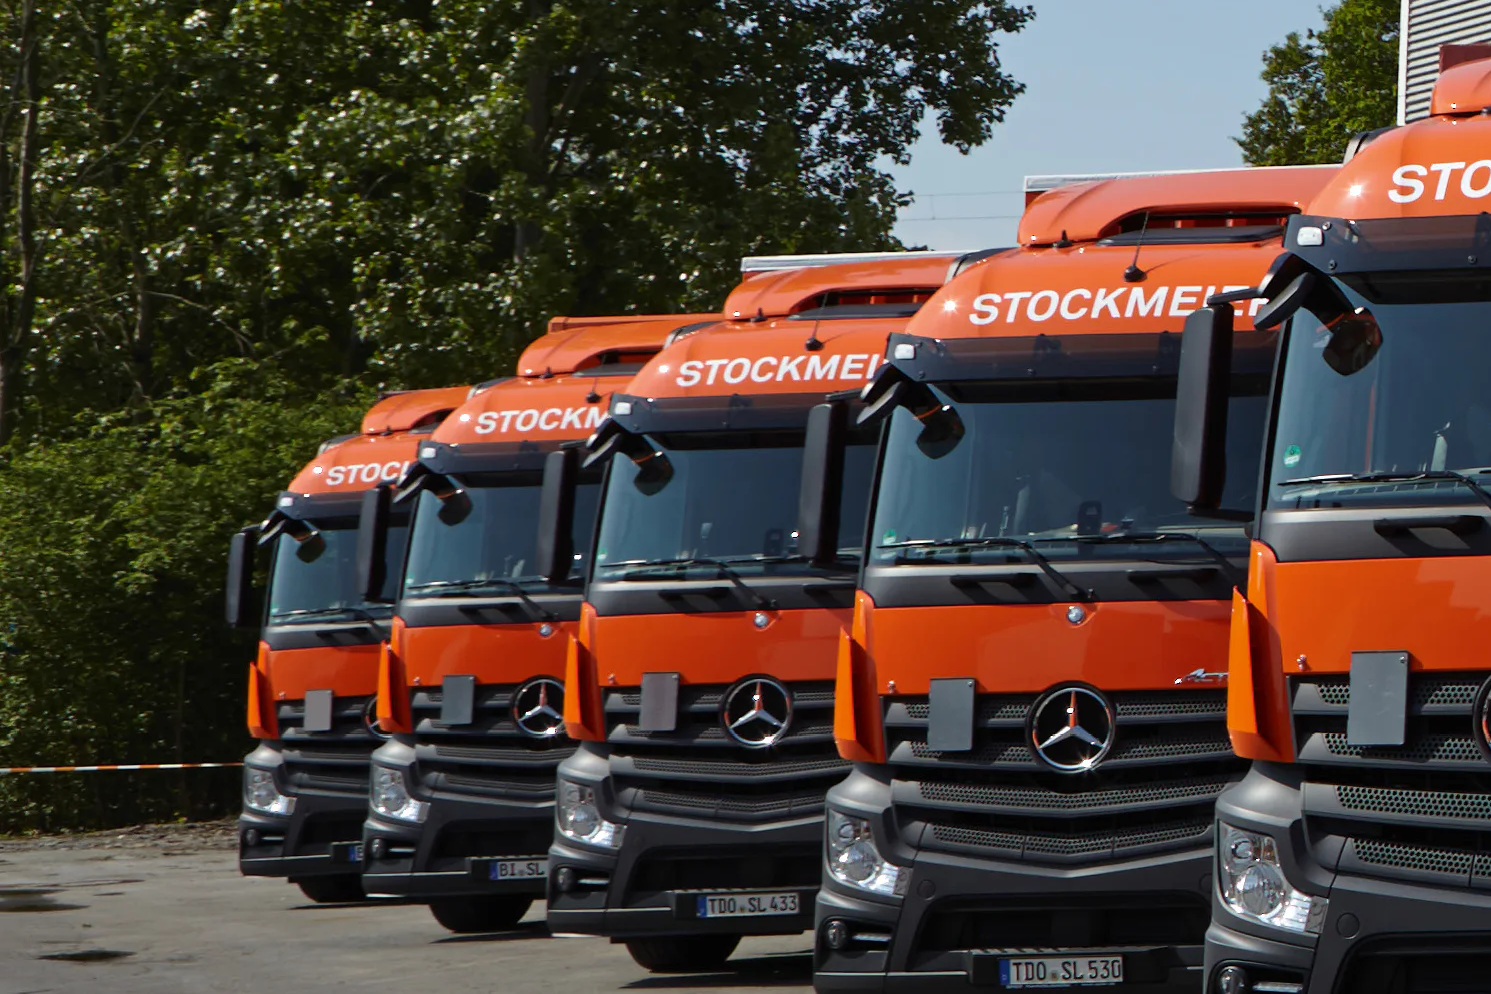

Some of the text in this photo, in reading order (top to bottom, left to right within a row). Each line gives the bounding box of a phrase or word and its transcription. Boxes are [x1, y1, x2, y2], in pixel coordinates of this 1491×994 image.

[675, 353, 890, 387] STOCKMEI
[708, 895, 797, 915] TDO SL 433
[1012, 960, 1047, 982] TDO
[1061, 960, 1085, 980] SL
[1087, 959, 1121, 980] 530
